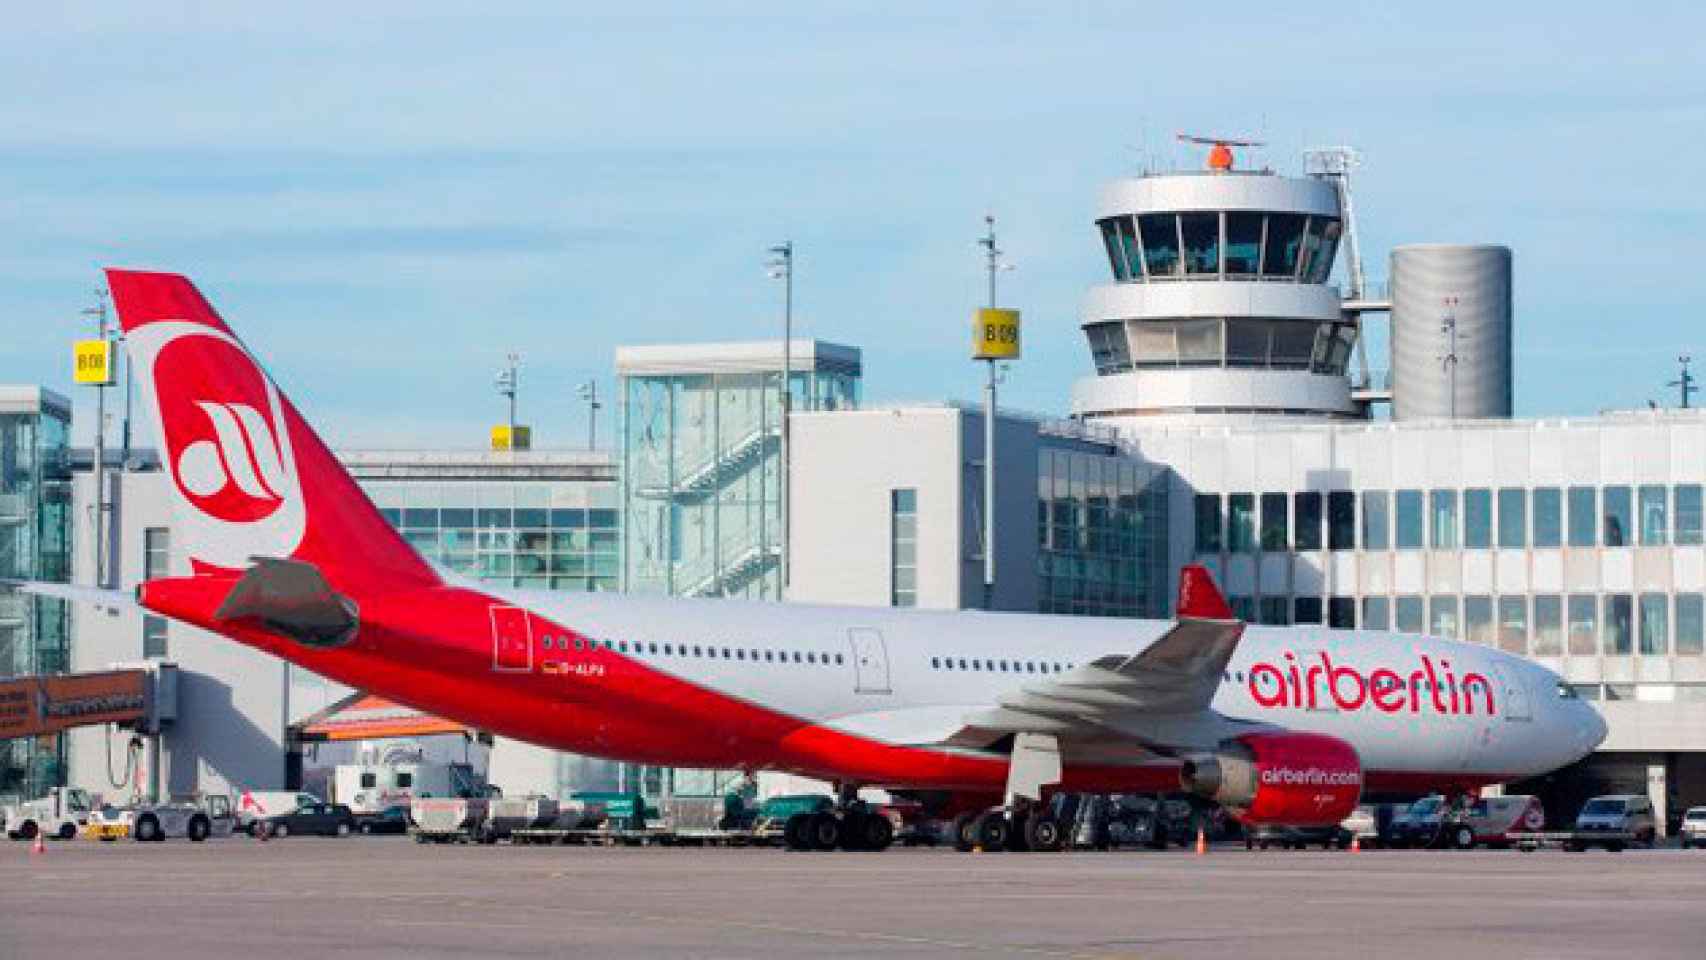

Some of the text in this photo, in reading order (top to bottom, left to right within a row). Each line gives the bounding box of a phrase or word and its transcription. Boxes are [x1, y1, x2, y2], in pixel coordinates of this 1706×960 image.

[986, 323, 1017, 344] B 09
[78, 353, 87, 370] B
[1249, 650, 1495, 714] airberlin
[1262, 766, 1360, 785] airberlin.com
